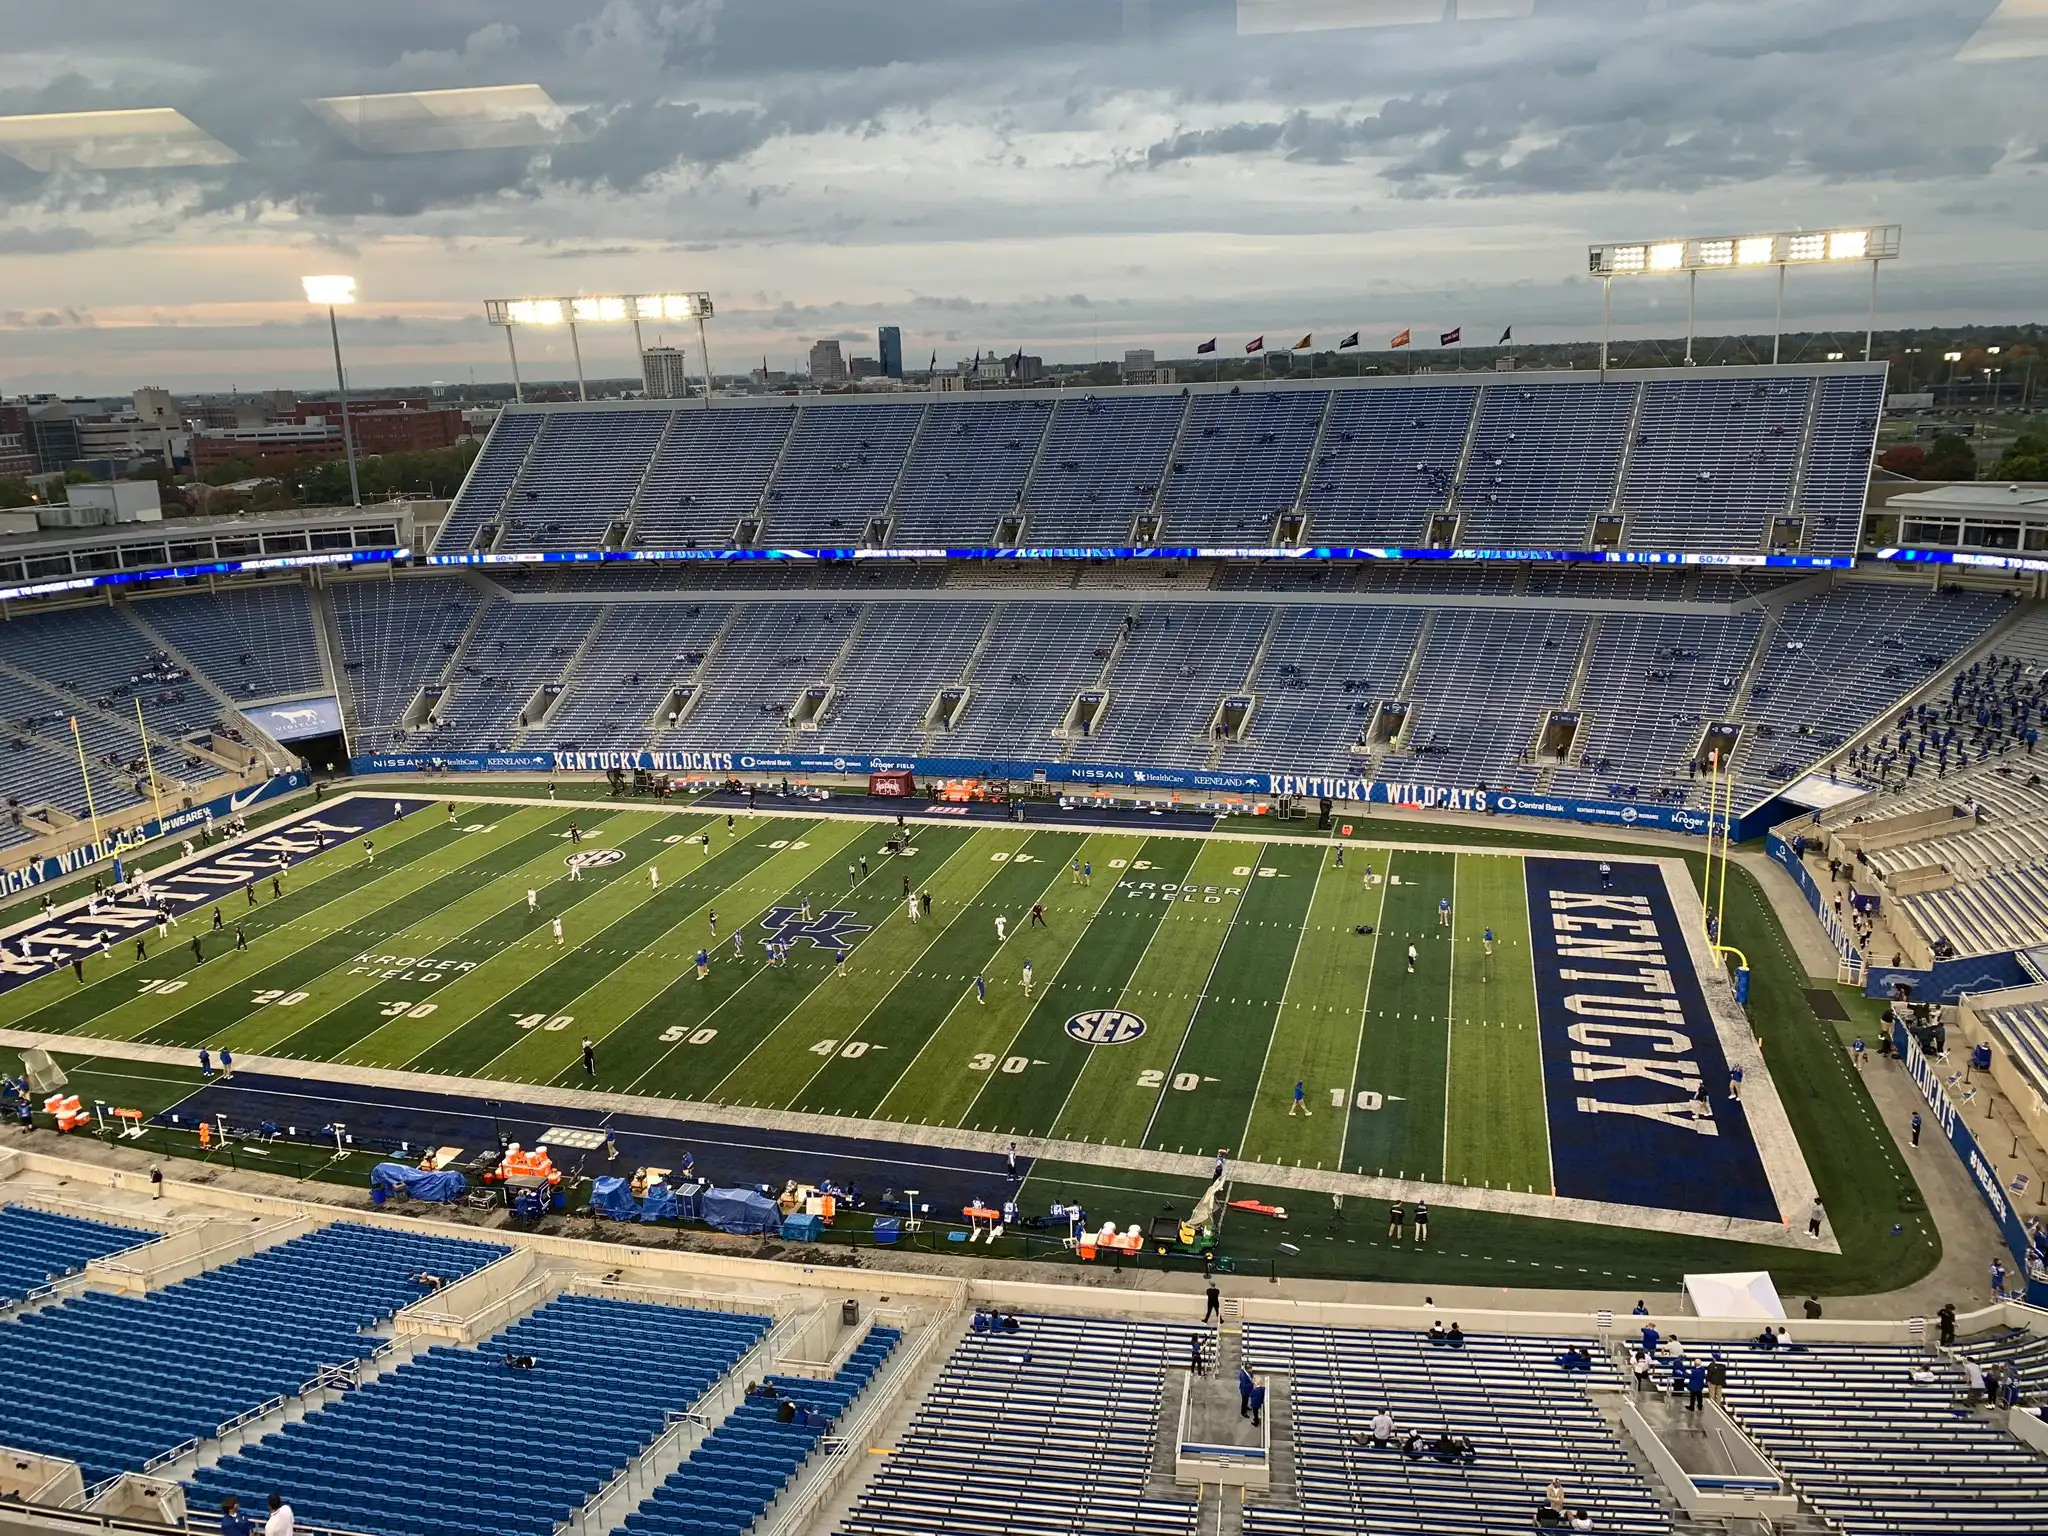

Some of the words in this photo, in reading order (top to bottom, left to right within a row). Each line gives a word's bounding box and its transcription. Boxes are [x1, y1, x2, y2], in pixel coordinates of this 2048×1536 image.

[898, 549, 927, 557] KROGER
[927, 549, 947, 557] FIELD
[1200, 549, 1237, 557] WELCOME
[1237, 549, 1248, 557] TO
[1249, 549, 1280, 557] KROGER
[1698, 555, 1729, 564] 60:47
[1953, 553, 2006, 566] WELCOME
[2009, 558, 2022, 568] TO
[373, 758, 424, 767] NISSAN
[487, 757, 530, 766] KEENELAND
[553, 752, 643, 770] KENTUCKY
[651, 751, 733, 770] WILDCATS
[869, 758, 895, 772] Kroger
[1072, 769, 1124, 779] NISSAN
[1146, 773, 1184, 783] HealthCare
[1194, 776, 1243, 787] KEENELAND
[1268, 774, 1376, 801] KENTUCKY
[1386, 783, 1487, 811] WILDCATS
[1518, 801, 1545, 811] Central
[1545, 803, 1565, 812] Bank
[1671, 811, 1704, 829] Kroger
[990, 852, 1034, 863] 40
[1107, 859, 1154, 870] 30
[1232, 866, 1279, 878] 20
[1118, 880, 1242, 896] KROGER
[1127, 890, 1222, 905] FIELD
[352, 953, 479, 972] KROGER
[347, 967, 444, 983] FIELD
[137, 979, 189, 995] 10
[250, 990, 310, 1006] 20
[380, 1001, 440, 1019] 30
[1549, 890, 1719, 1136] KENTUCKY
[516, 1013, 575, 1032] 40
[1068, 1012, 1142, 1043] SEC
[658, 1026, 719, 1045] 50
[808, 1039, 870, 1059] 40
[967, 1052, 1029, 1074] 30
[1136, 1068, 1200, 1092] 20
[1906, 1035, 1957, 1140] WILDCATS
[1329, 1088, 1383, 1110] 10
